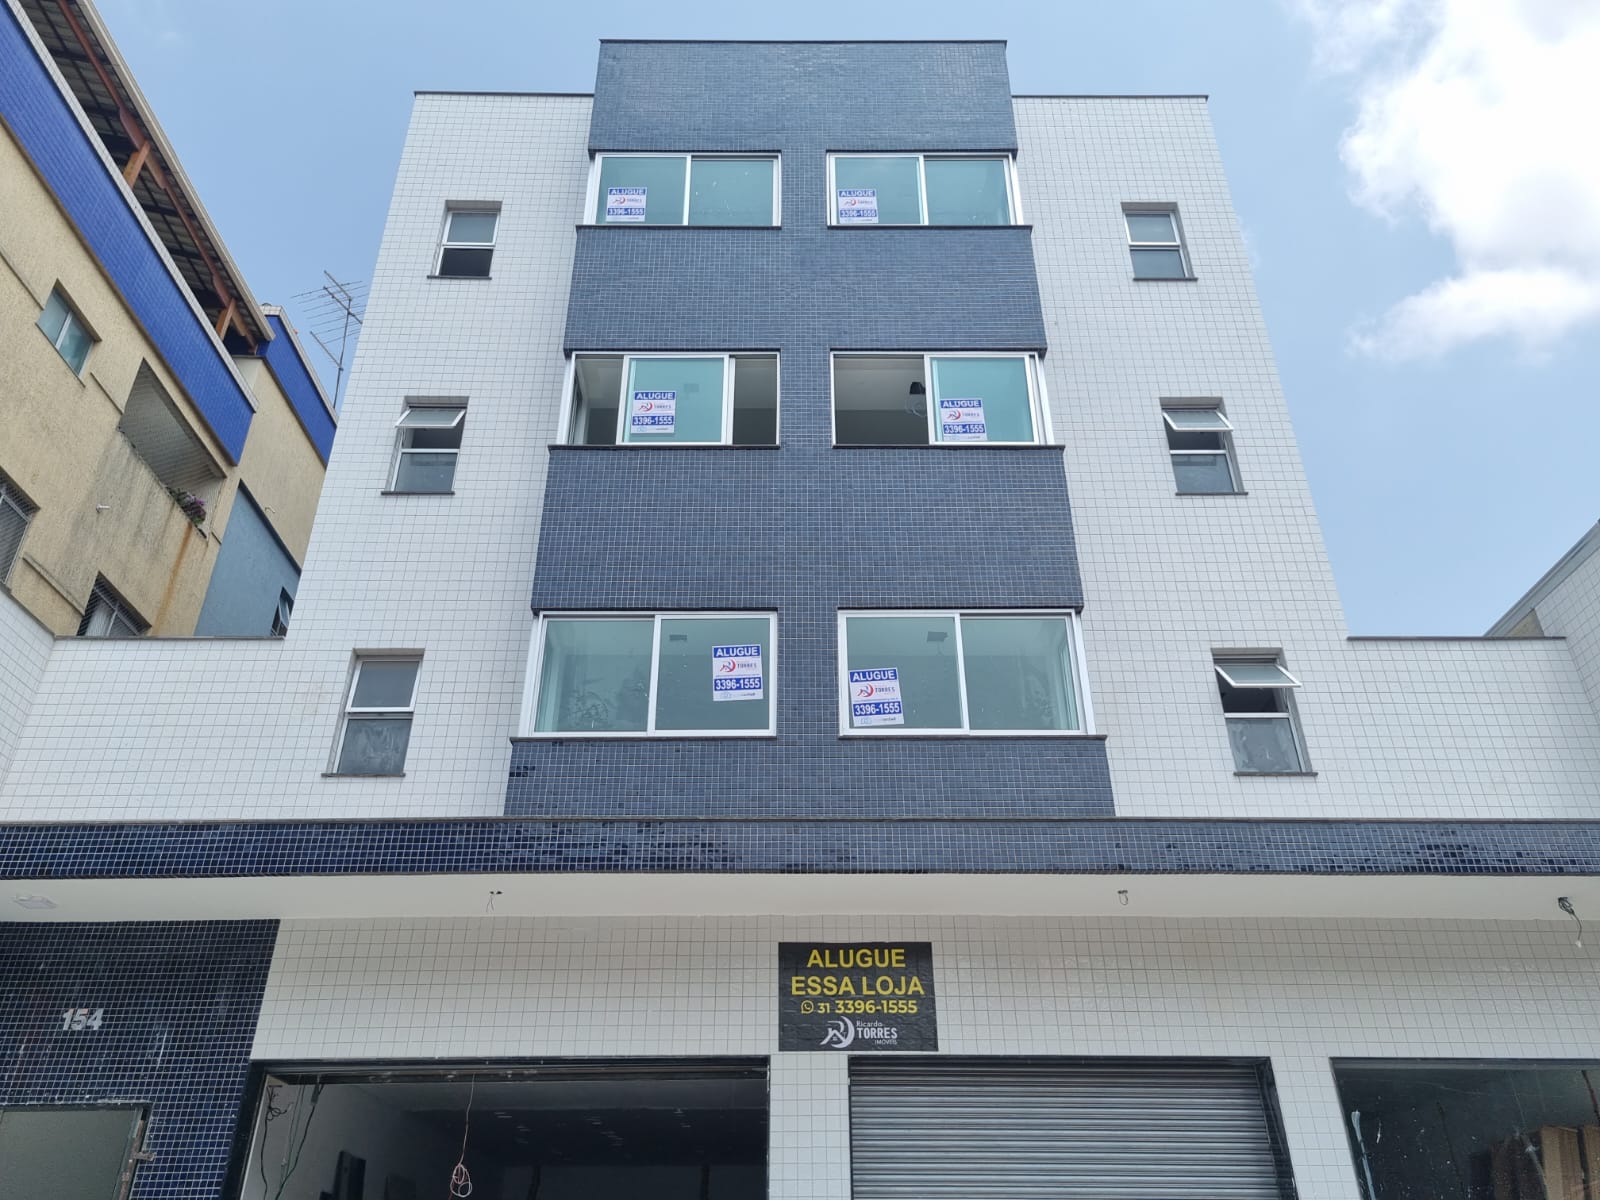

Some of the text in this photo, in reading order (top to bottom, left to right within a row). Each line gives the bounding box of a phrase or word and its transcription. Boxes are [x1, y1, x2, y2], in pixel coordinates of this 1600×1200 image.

[840, 209, 876, 217] 3396-1555
[636, 392, 674, 400] ALUGUE
[943, 400, 980, 408] ALUGUE
[634, 416, 673, 425] 3396-1555
[944, 424, 984, 433] 3396-1555
[715, 646, 758, 657] ALUGUE
[852, 670, 895, 682] ALUGUE
[715, 678, 760, 690] 3396-1555
[855, 702, 900, 715] 3396-1555
[807, 949, 906, 968] ALUGUE
[791, 976, 925, 995] ESSA LOJA
[817, 1000, 918, 1014] 31 3396-1555
[62, 1008, 105, 1031] 154
[856, 1027, 898, 1039] TORRES
